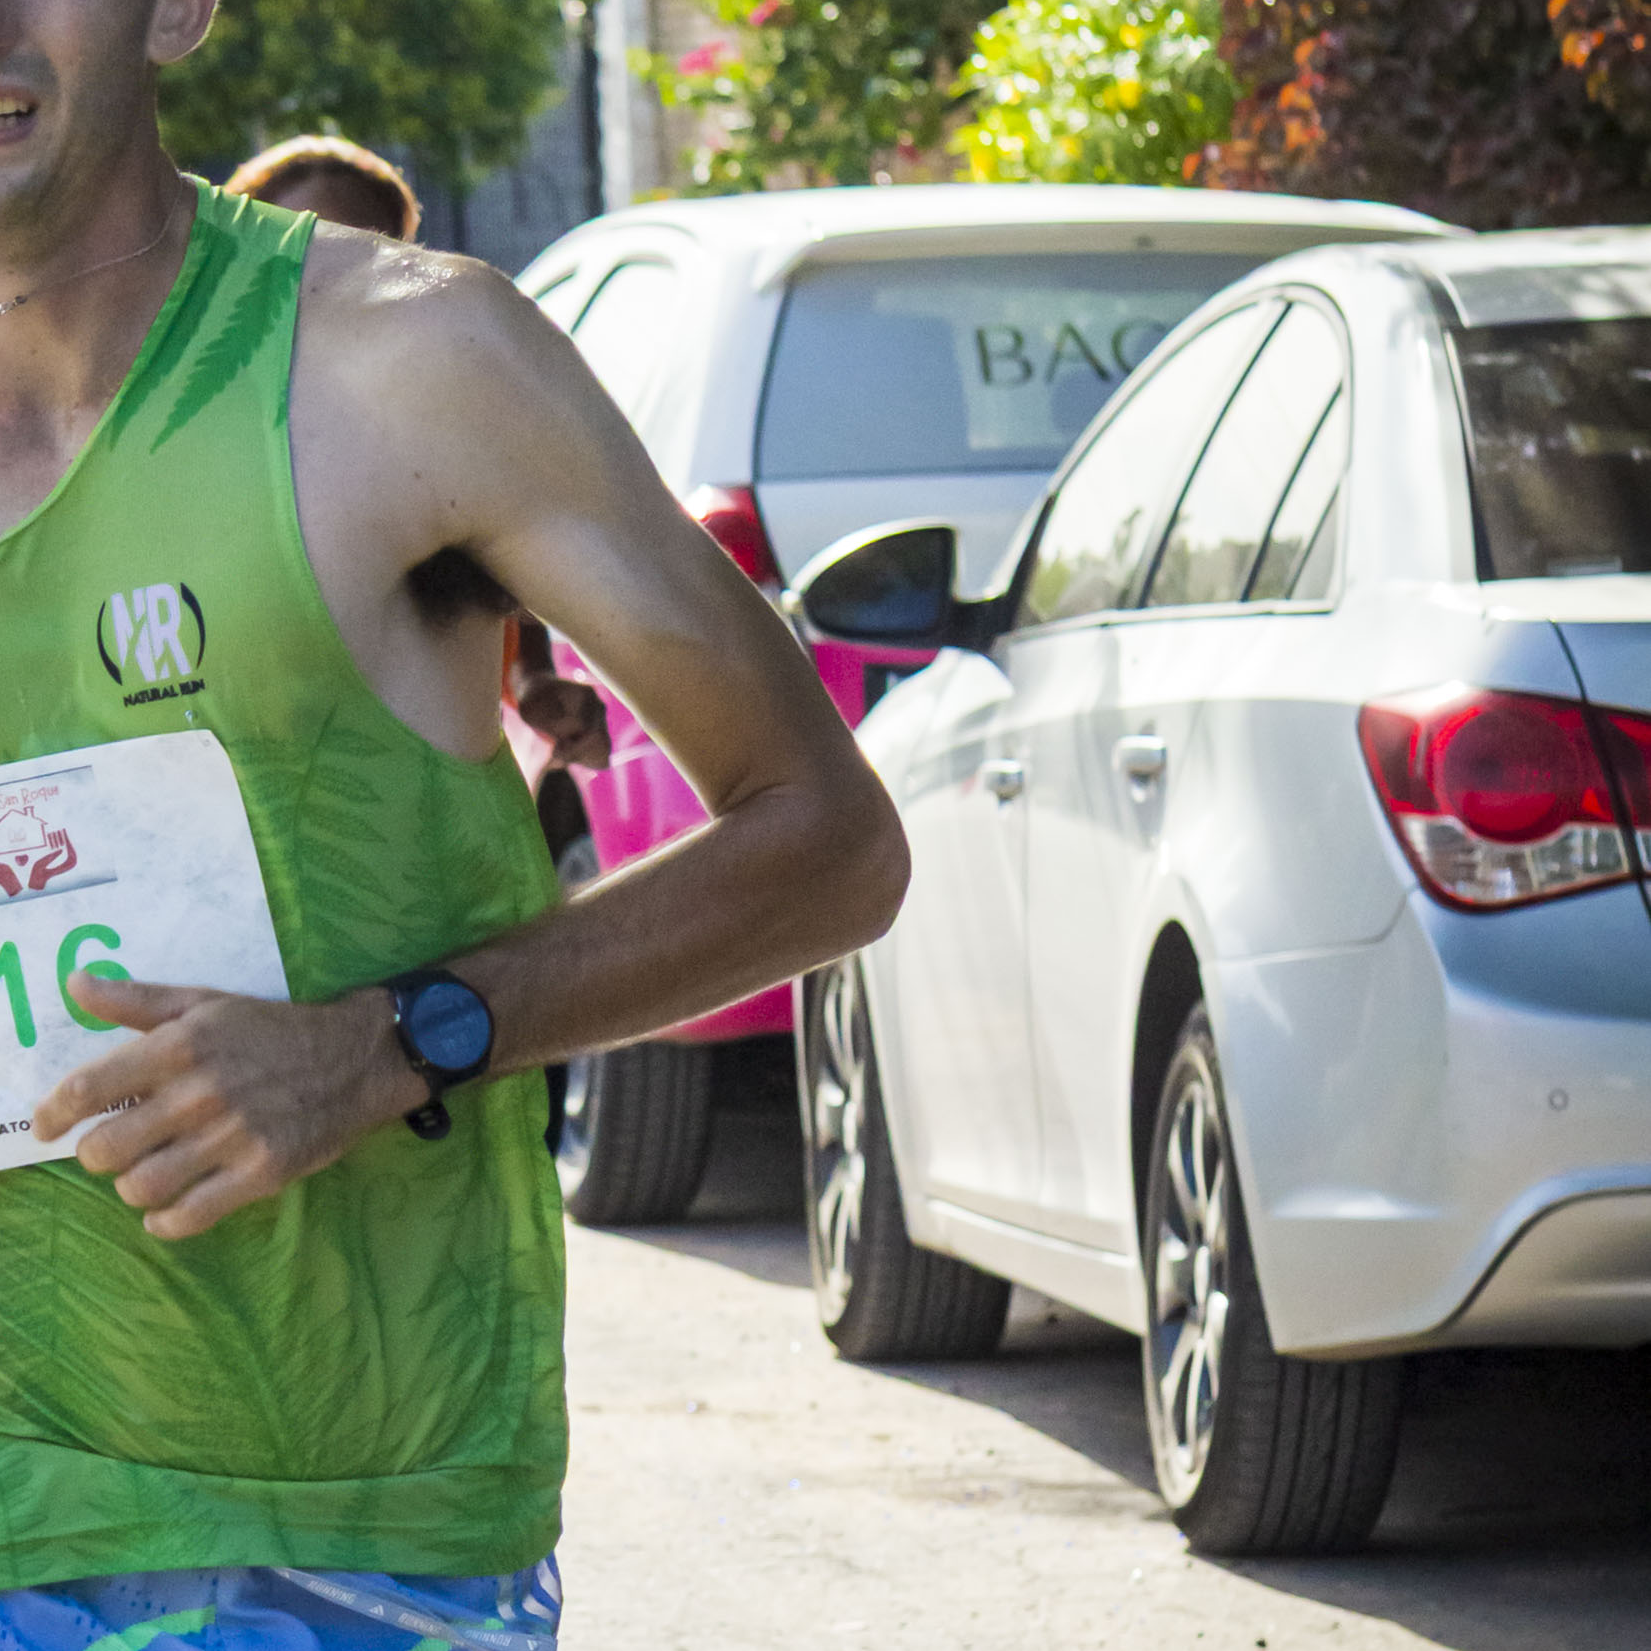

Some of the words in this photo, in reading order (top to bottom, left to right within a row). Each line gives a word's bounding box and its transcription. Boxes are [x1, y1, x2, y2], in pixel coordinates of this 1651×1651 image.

[123, 685, 178, 707] NATURAL
[179, 678, 205, 695] RUN
[21, 785, 59, 805] Roque
